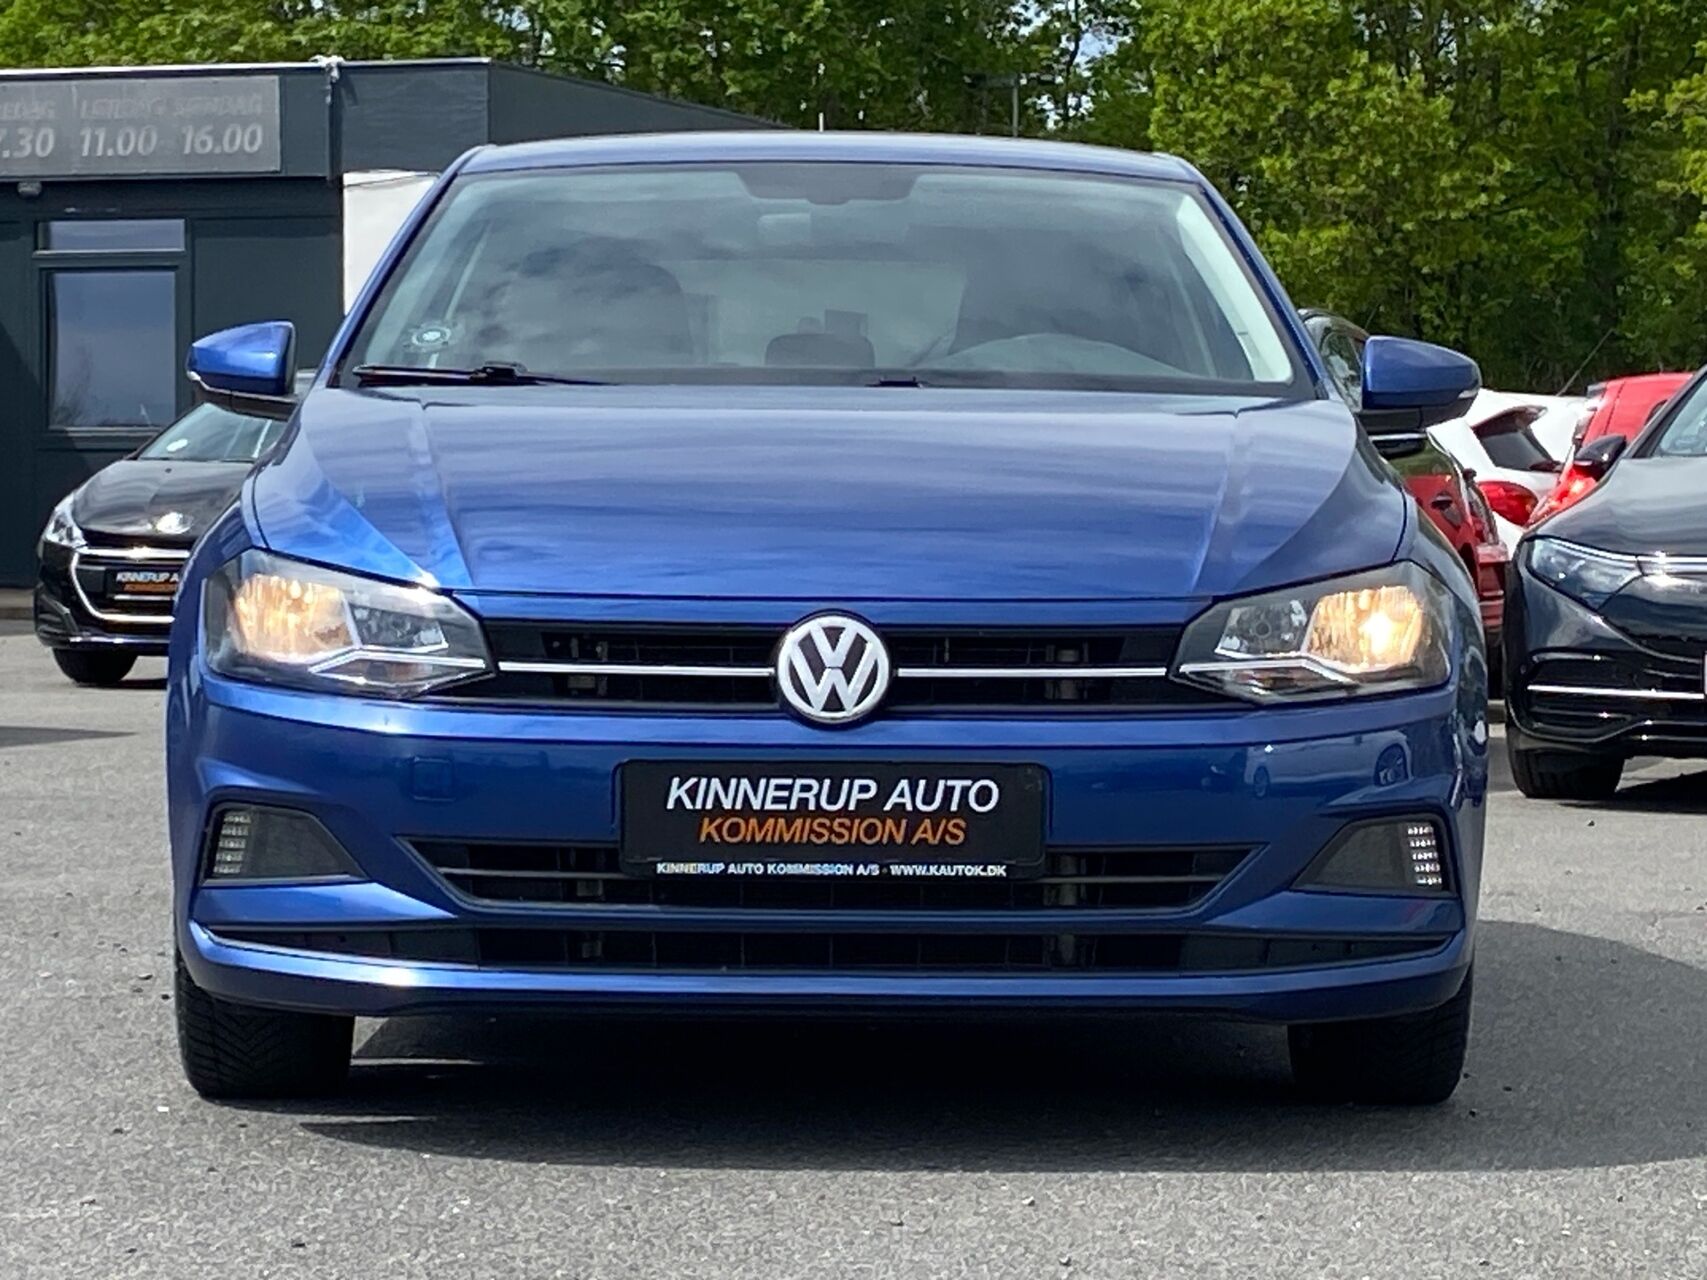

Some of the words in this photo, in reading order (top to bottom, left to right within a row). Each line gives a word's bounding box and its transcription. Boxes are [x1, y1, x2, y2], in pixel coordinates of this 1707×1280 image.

[80, 125, 158, 156] 11.00
[182, 123, 263, 154] 16.00
[666, 777, 878, 811] KINNERUP
[883, 779, 1000, 813] AUTO
[699, 817, 905, 845] KOMMISSION
[910, 818, 967, 845] A/S
[656, 862, 725, 875] KINNERUP
[727, 863, 764, 875] AUTO
[766, 863, 854, 876] KOMMISSION
[856, 864, 880, 876] A/S
[889, 864, 1007, 877] WWW.KAUTOK.DK
